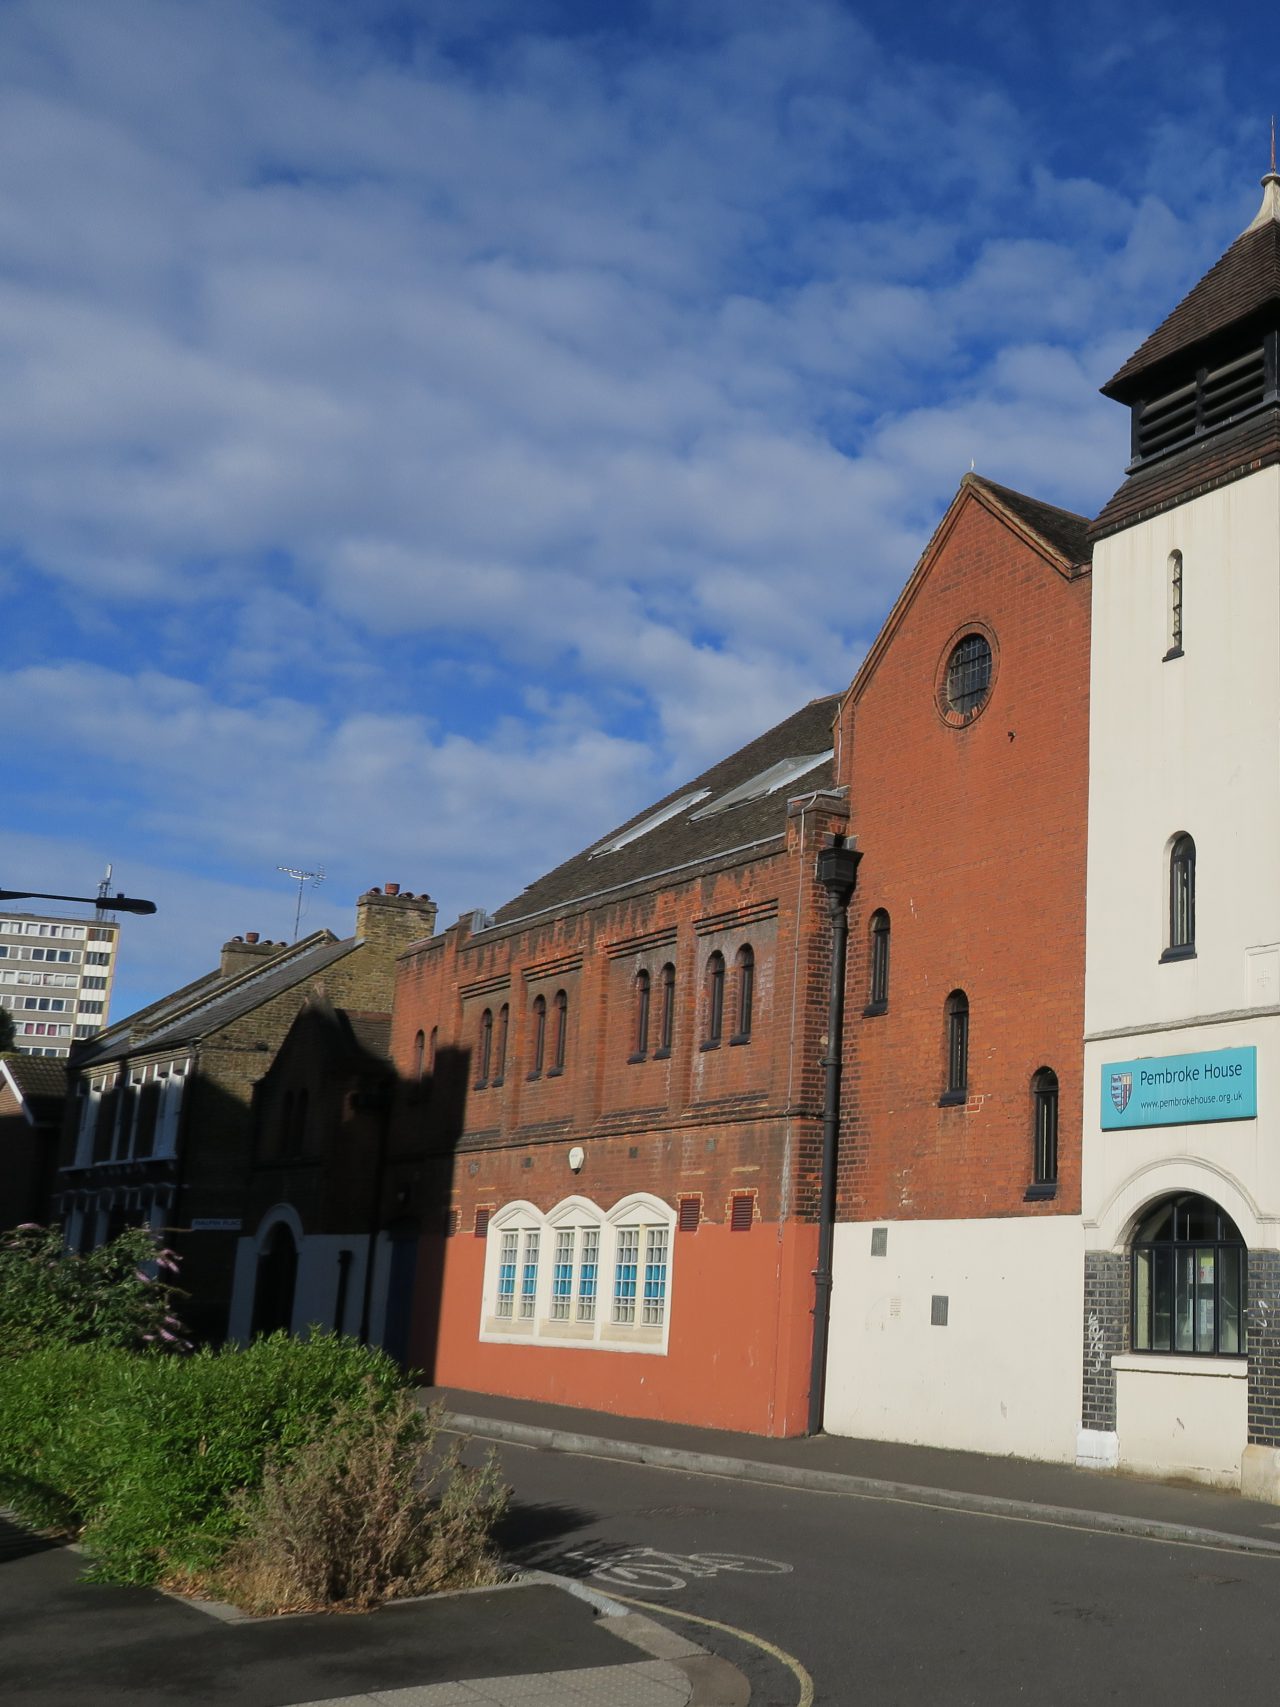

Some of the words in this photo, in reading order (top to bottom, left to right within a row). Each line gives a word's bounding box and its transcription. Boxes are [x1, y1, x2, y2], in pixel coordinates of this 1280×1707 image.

[1140, 1066, 1200, 1086] Pembroke
[1204, 1063, 1242, 1080] House
[1140, 1090, 1243, 1110] www.pembrokehouse.org.uk
